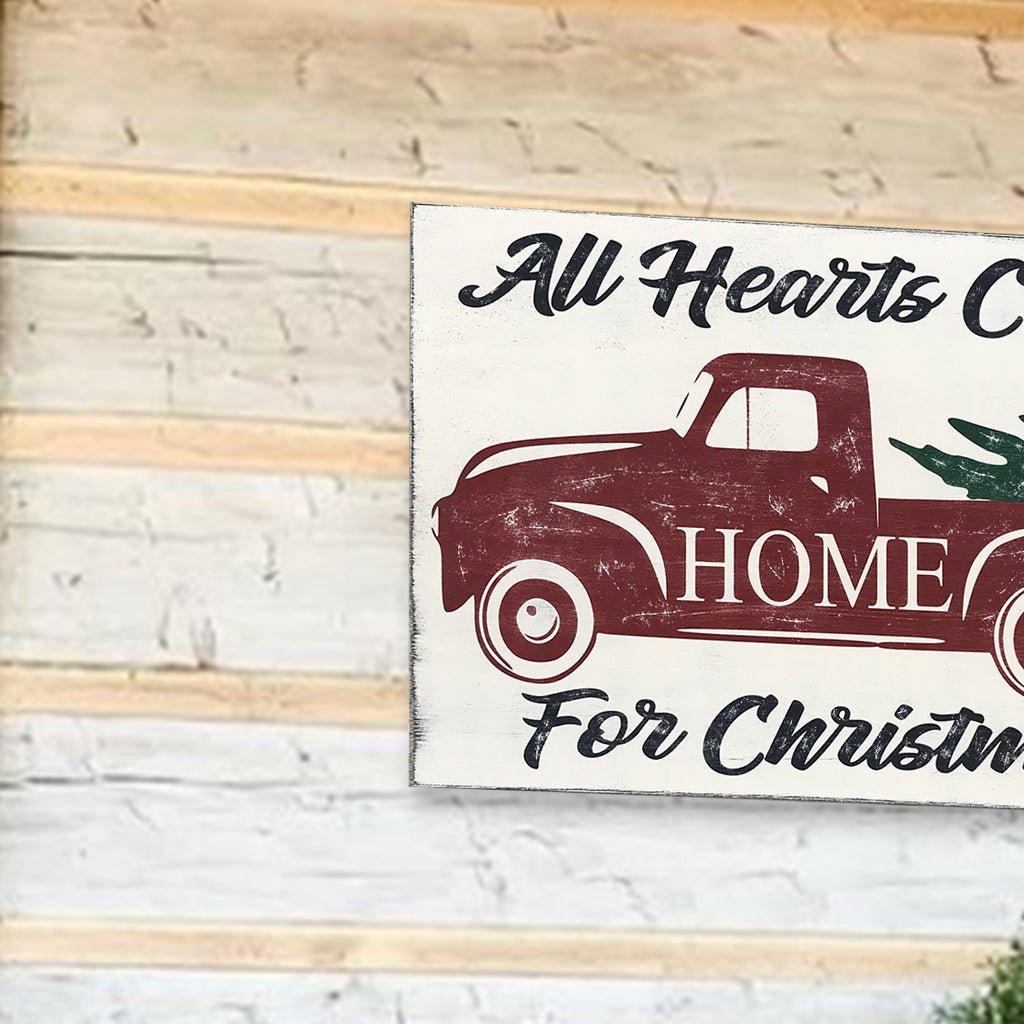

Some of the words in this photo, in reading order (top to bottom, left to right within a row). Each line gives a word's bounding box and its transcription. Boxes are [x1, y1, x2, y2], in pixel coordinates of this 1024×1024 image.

[459, 232, 625, 317] All
[639, 239, 948, 329] Hearts
[675, 525, 955, 613] HOME
[522, 687, 689, 770] For
